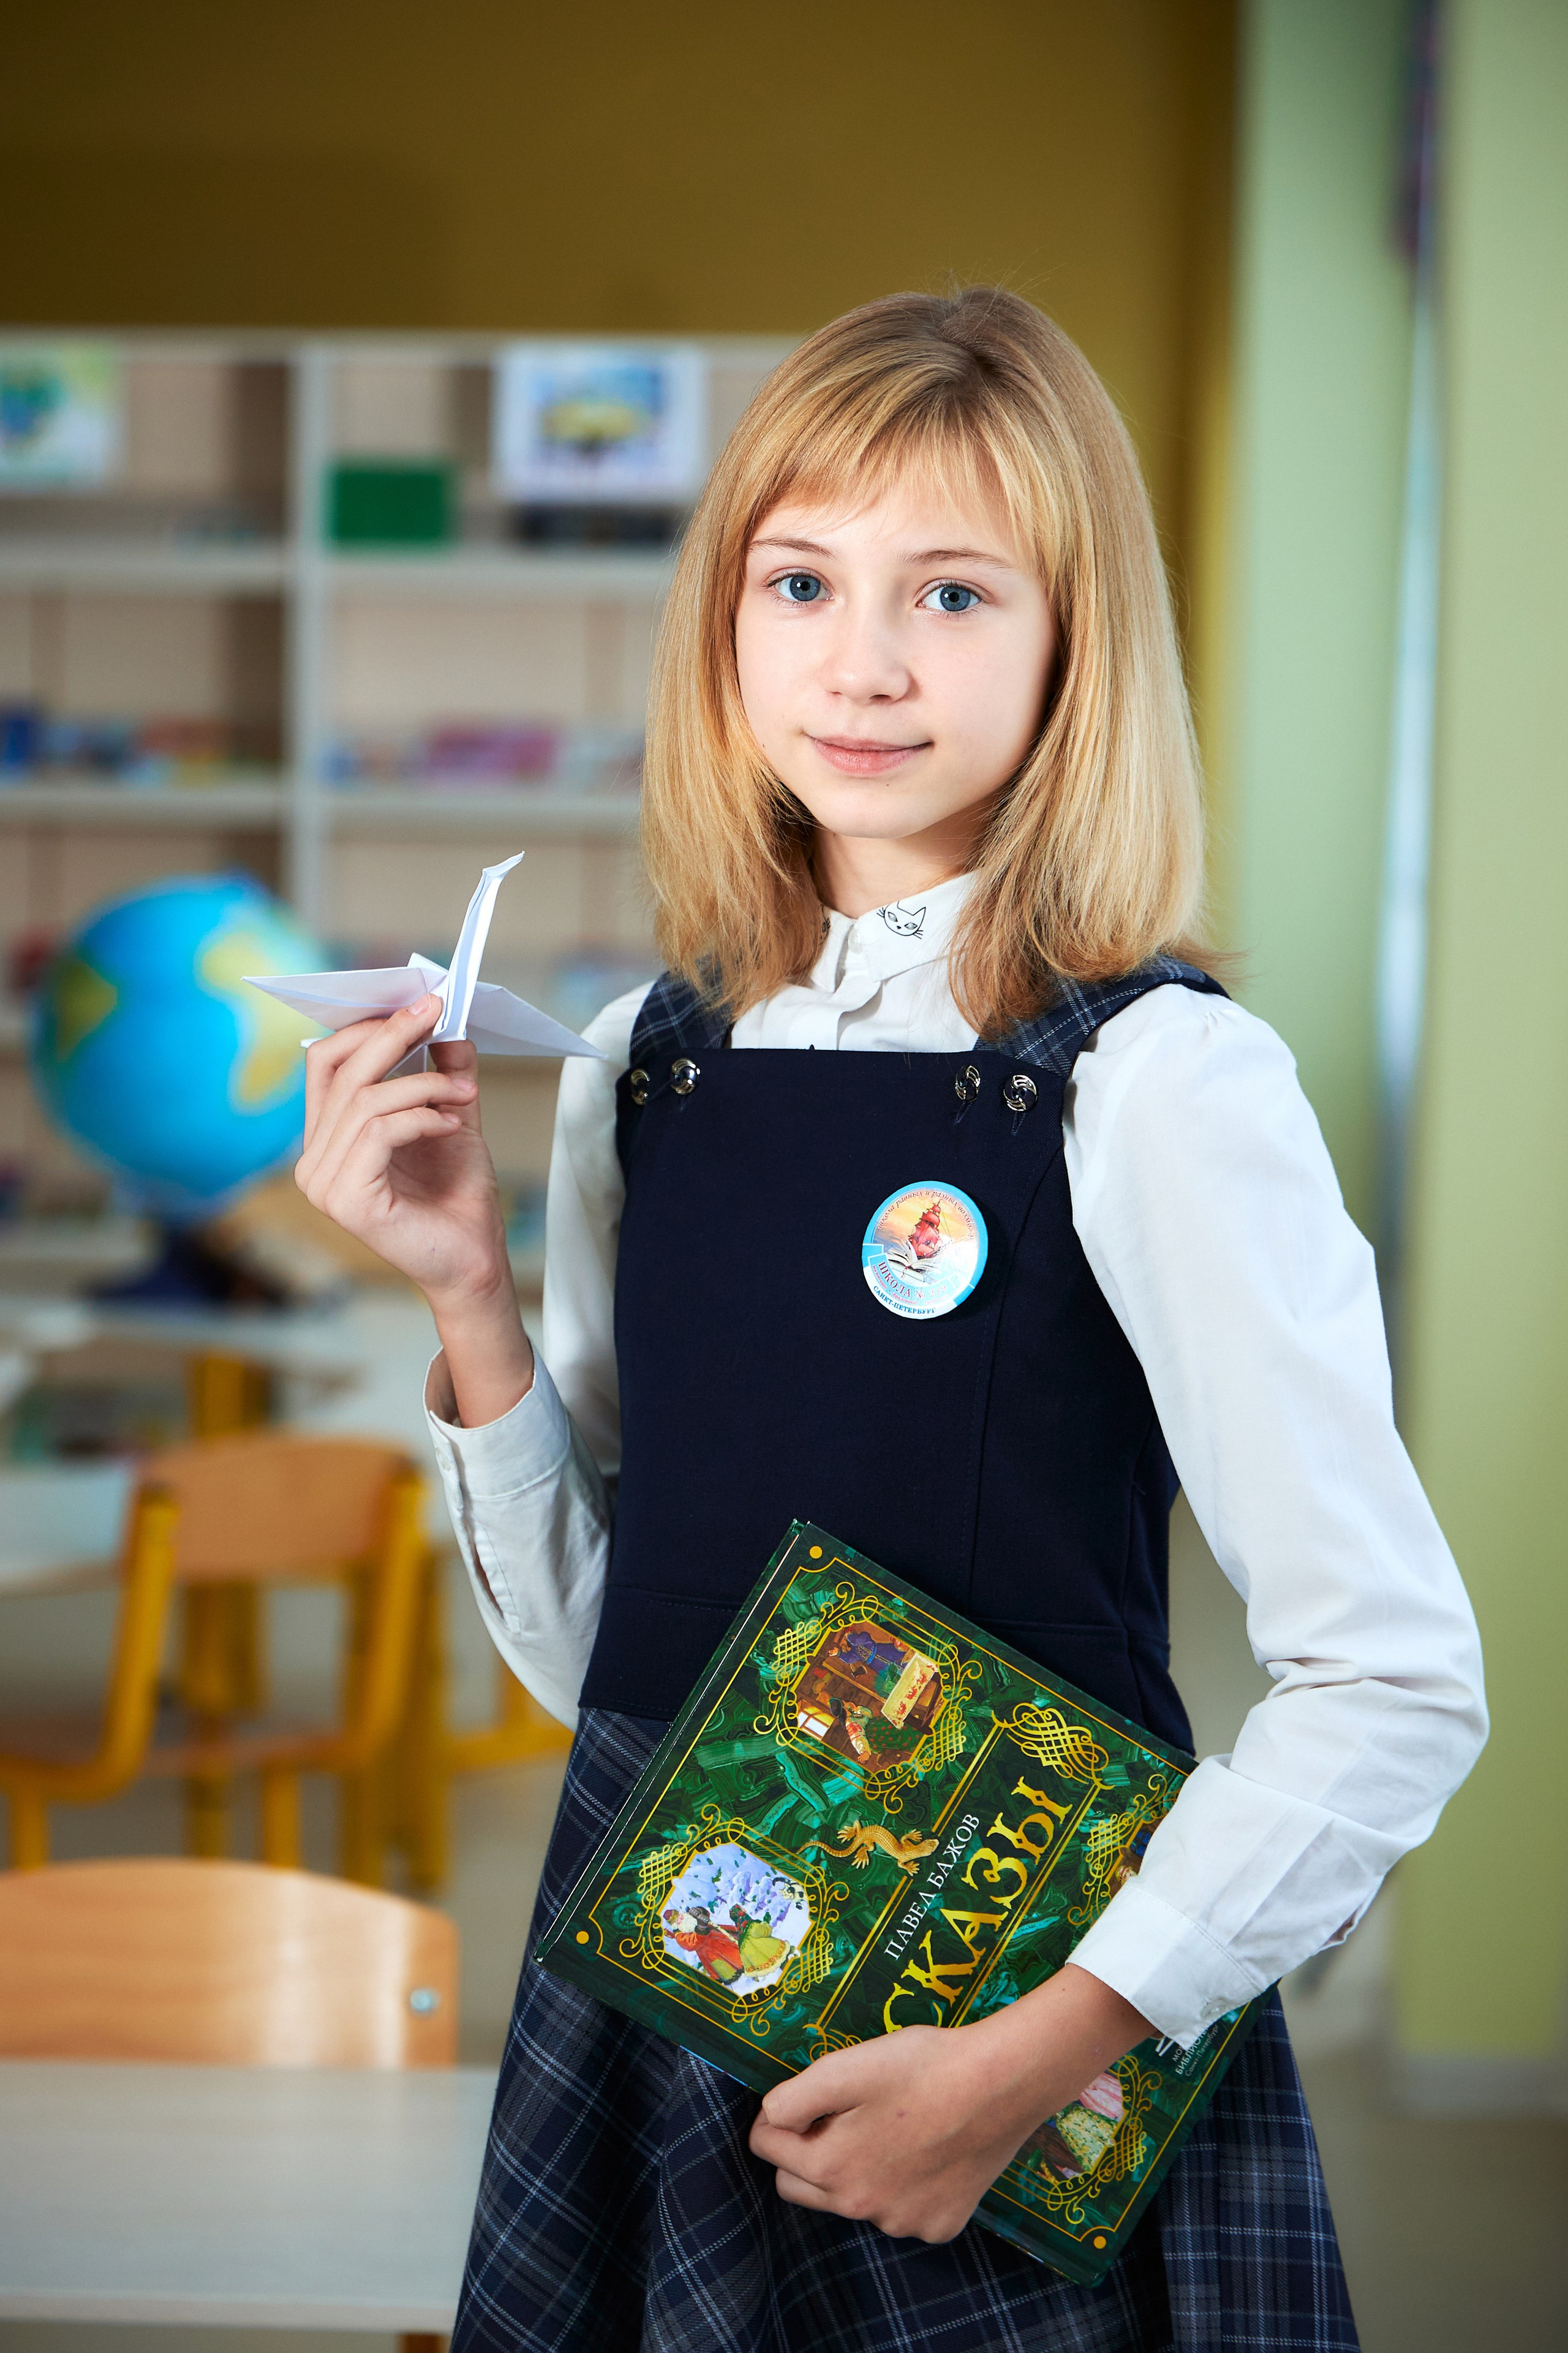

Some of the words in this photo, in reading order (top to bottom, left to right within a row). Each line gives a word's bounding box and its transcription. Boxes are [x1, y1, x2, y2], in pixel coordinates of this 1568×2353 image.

[878, 1206, 895, 1229] школа
[895, 1192, 924, 1207] равных
[931, 1191, 959, 1208] разных
[873, 1286, 936, 1315] САНКТ-ПЕТЕРБУРГ
[878, 1261, 911, 1297] ШКОЛА
[915, 1290, 925, 1299] №
[930, 1285, 947, 1297] 219
[883, 1775, 1072, 2034] СКАЗЫ
[884, 1891, 936, 1961] ПАВЕЛ
[927, 1813, 980, 1890] БАЖОВ
[1175, 2028, 1208, 2075] БИБЛИО
[1185, 2025, 1219, 2076] Санкт-Петербург
